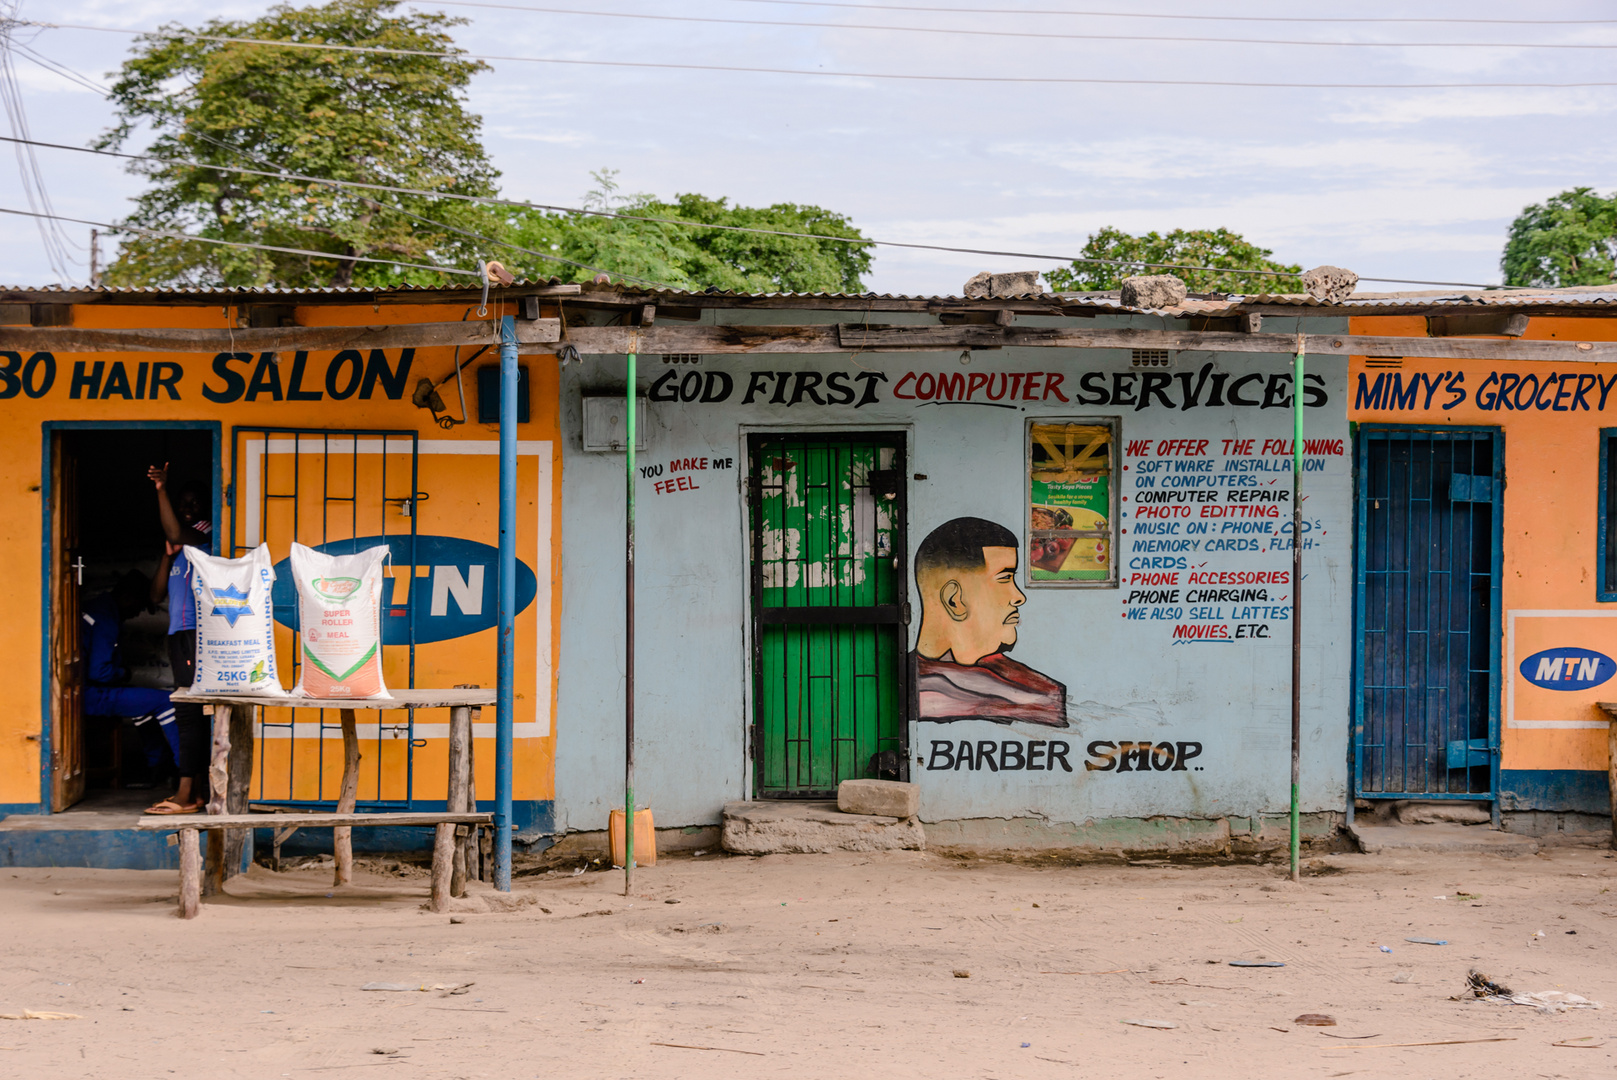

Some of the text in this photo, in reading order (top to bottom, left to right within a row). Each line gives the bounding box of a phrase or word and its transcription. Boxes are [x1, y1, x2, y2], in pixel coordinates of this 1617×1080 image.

[69, 360, 184, 401] HAIR
[202, 348, 416, 404] SALON
[649, 362, 1329, 412] GOD FIRST COMPUTER SERVICES
[1354, 371, 1617, 412] MIMY'S GROCERY
[1126, 439, 1153, 457] WE
[1156, 439, 1210, 457] OFFER
[1221, 439, 1256, 456] THE
[640, 457, 733, 479] YOU MAKE ME
[1135, 458, 1326, 474] SOFTWARE INSTALLAION
[653, 476, 700, 495] FEEL
[1135, 475, 1155, 488] ON
[1134, 489, 1290, 504] COMPUTER REPAIR
[1134, 505, 1192, 519] PHOTO
[1132, 521, 1181, 535] MUSIC
[1131, 538, 1201, 553] MEMORY
[1268, 537, 1321, 551] FLAH-
[1129, 570, 1290, 586] PHONE ACCESSORIES
[384, 565, 484, 617] TN
[1127, 589, 1180, 604] PHONE
[324, 609, 351, 617] SUPER
[1127, 607, 1148, 620] WE
[1149, 606, 1183, 620] ALSO
[1189, 606, 1224, 620] SELL
[264, 595, 273, 650] MILLING
[321, 618, 353, 626] ROLLER
[267, 654, 275, 680] APG
[1534, 657, 1600, 681] MTN
[217, 671, 247, 681] 25KG
[330, 685, 351, 693] 25Kg
[926, 740, 1073, 772] BARBER
